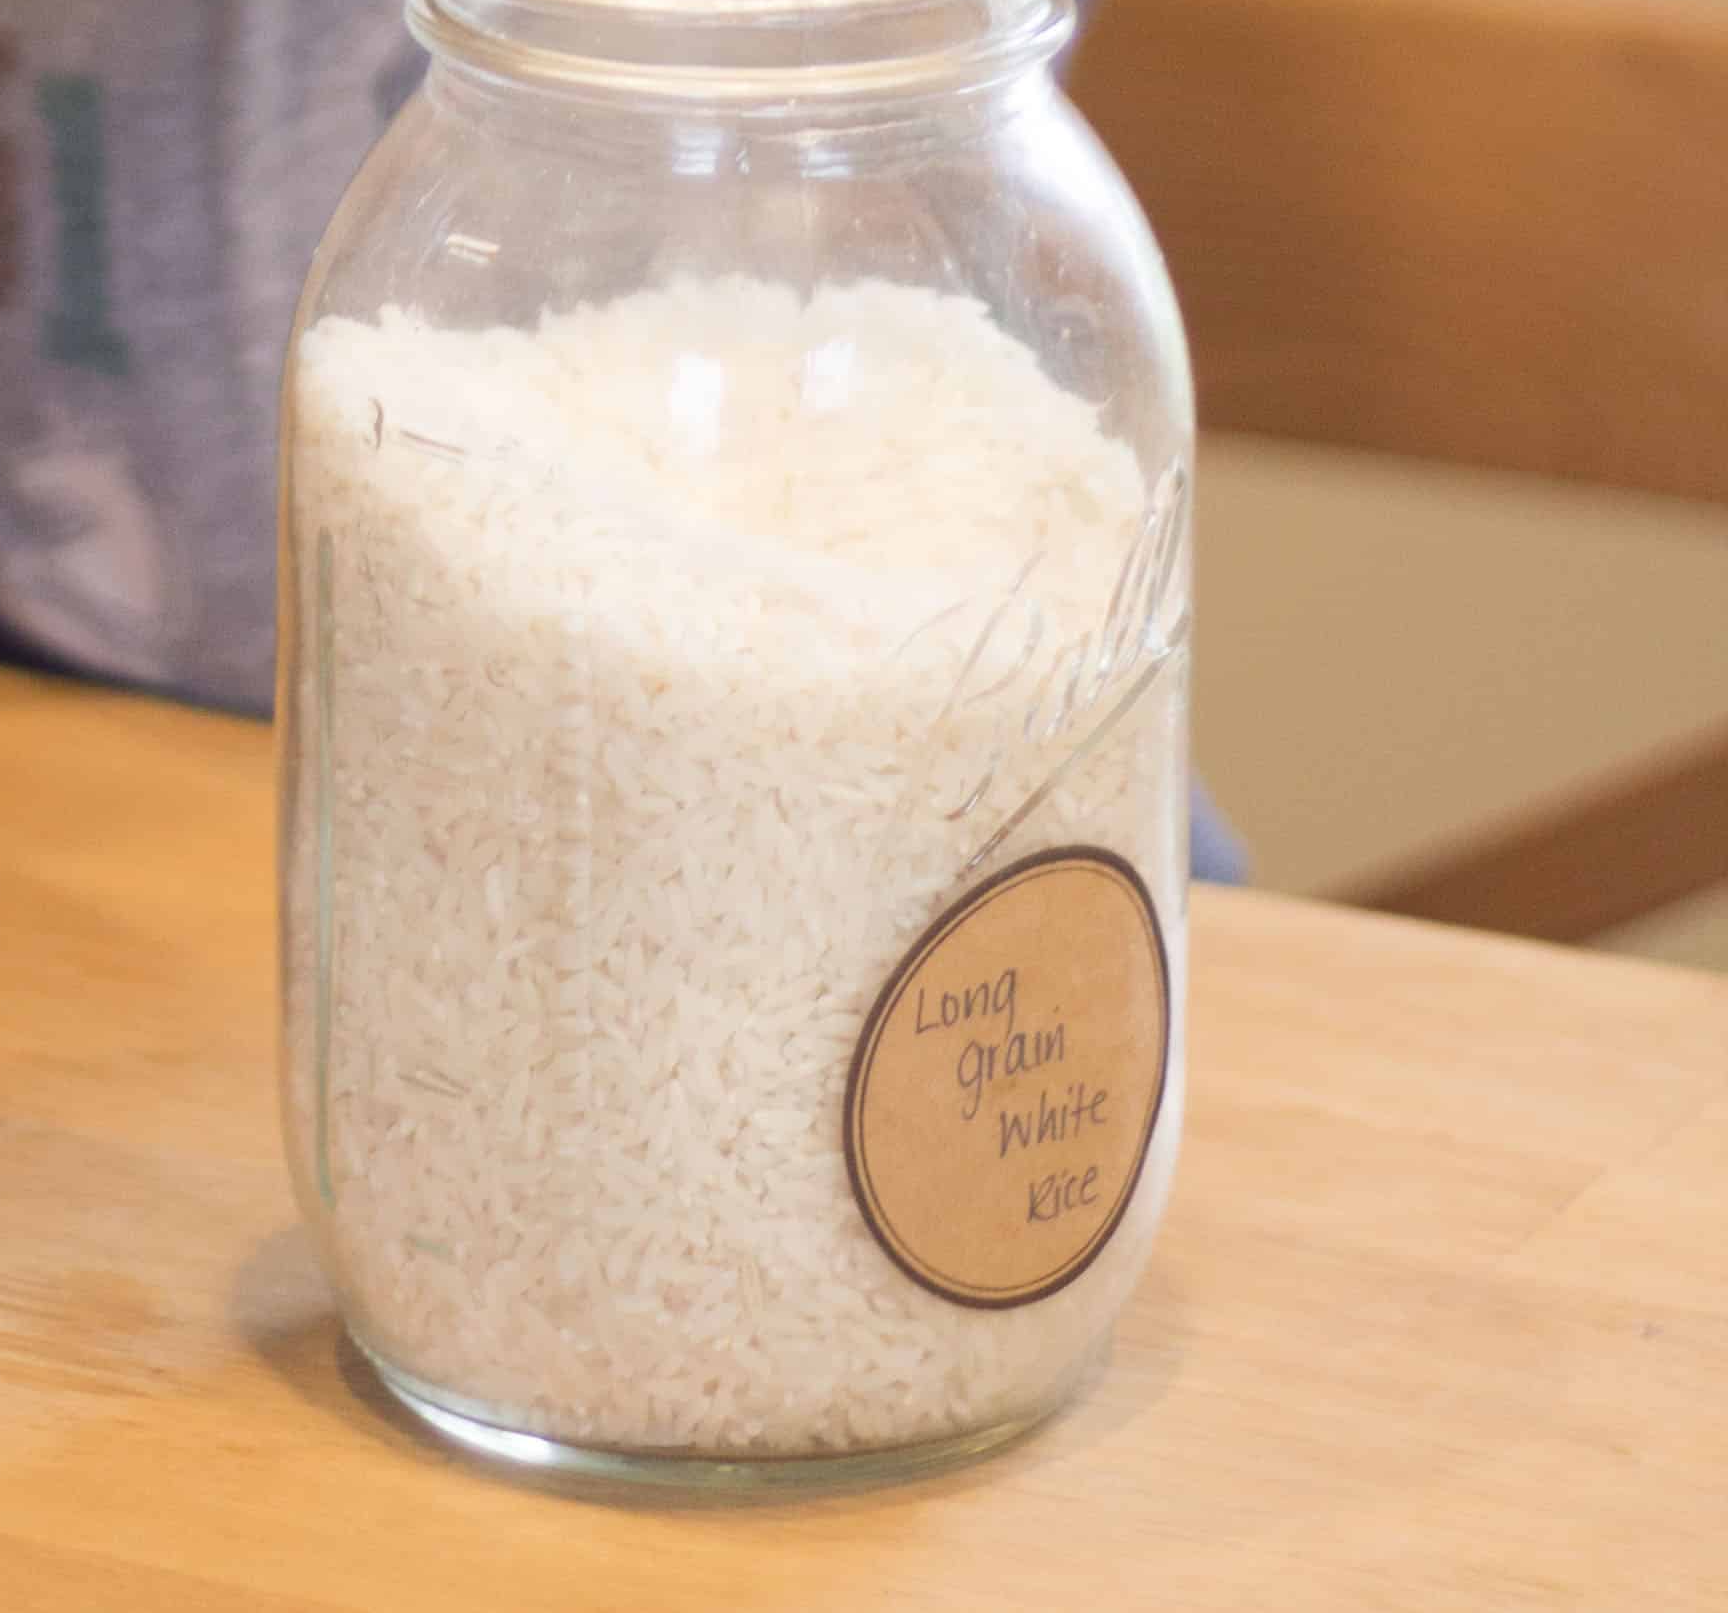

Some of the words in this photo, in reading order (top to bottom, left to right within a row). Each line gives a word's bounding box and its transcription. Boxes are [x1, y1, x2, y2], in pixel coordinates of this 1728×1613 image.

[914, 967, 1017, 1042] Long
[956, 1004, 1066, 1121] grain
[1026, 1164, 1100, 1224] Rice
